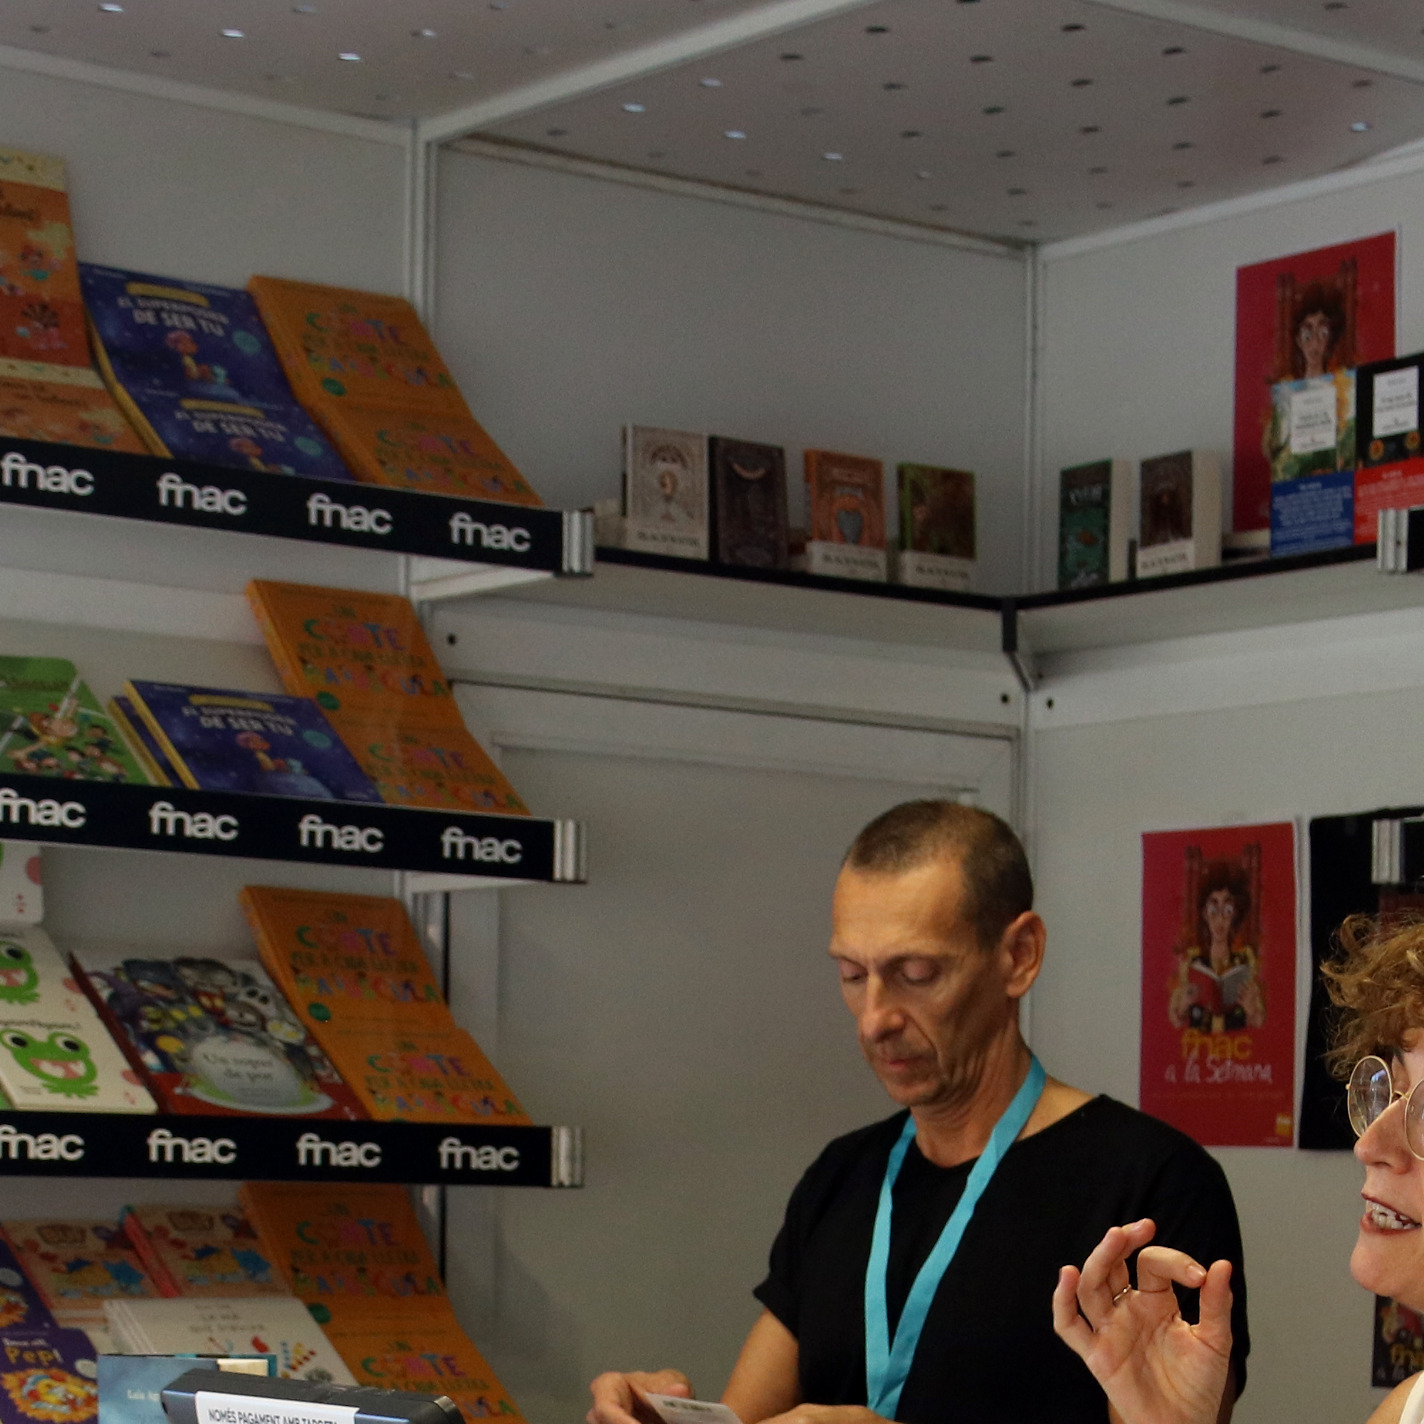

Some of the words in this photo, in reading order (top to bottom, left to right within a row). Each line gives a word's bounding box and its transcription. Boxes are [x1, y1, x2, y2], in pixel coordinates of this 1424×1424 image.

[0, 452, 93, 495] fnac
[157, 473, 246, 515] fnac
[307, 493, 392, 534] fnac
[449, 512, 530, 552] fnac
[149, 801, 238, 840] fnac
[299, 814, 383, 852] fnac
[441, 827, 521, 863] fnac
[1181, 1030, 1252, 1059] fnac
[1184, 1047, 1201, 1083] la
[1205, 1054, 1272, 1085] Setmana
[147, 1129, 236, 1163] fnac
[296, 1133, 381, 1167] fnac
[439, 1137, 518, 1170] fnac
[208, 1408, 237, 1424] NOMÉS
